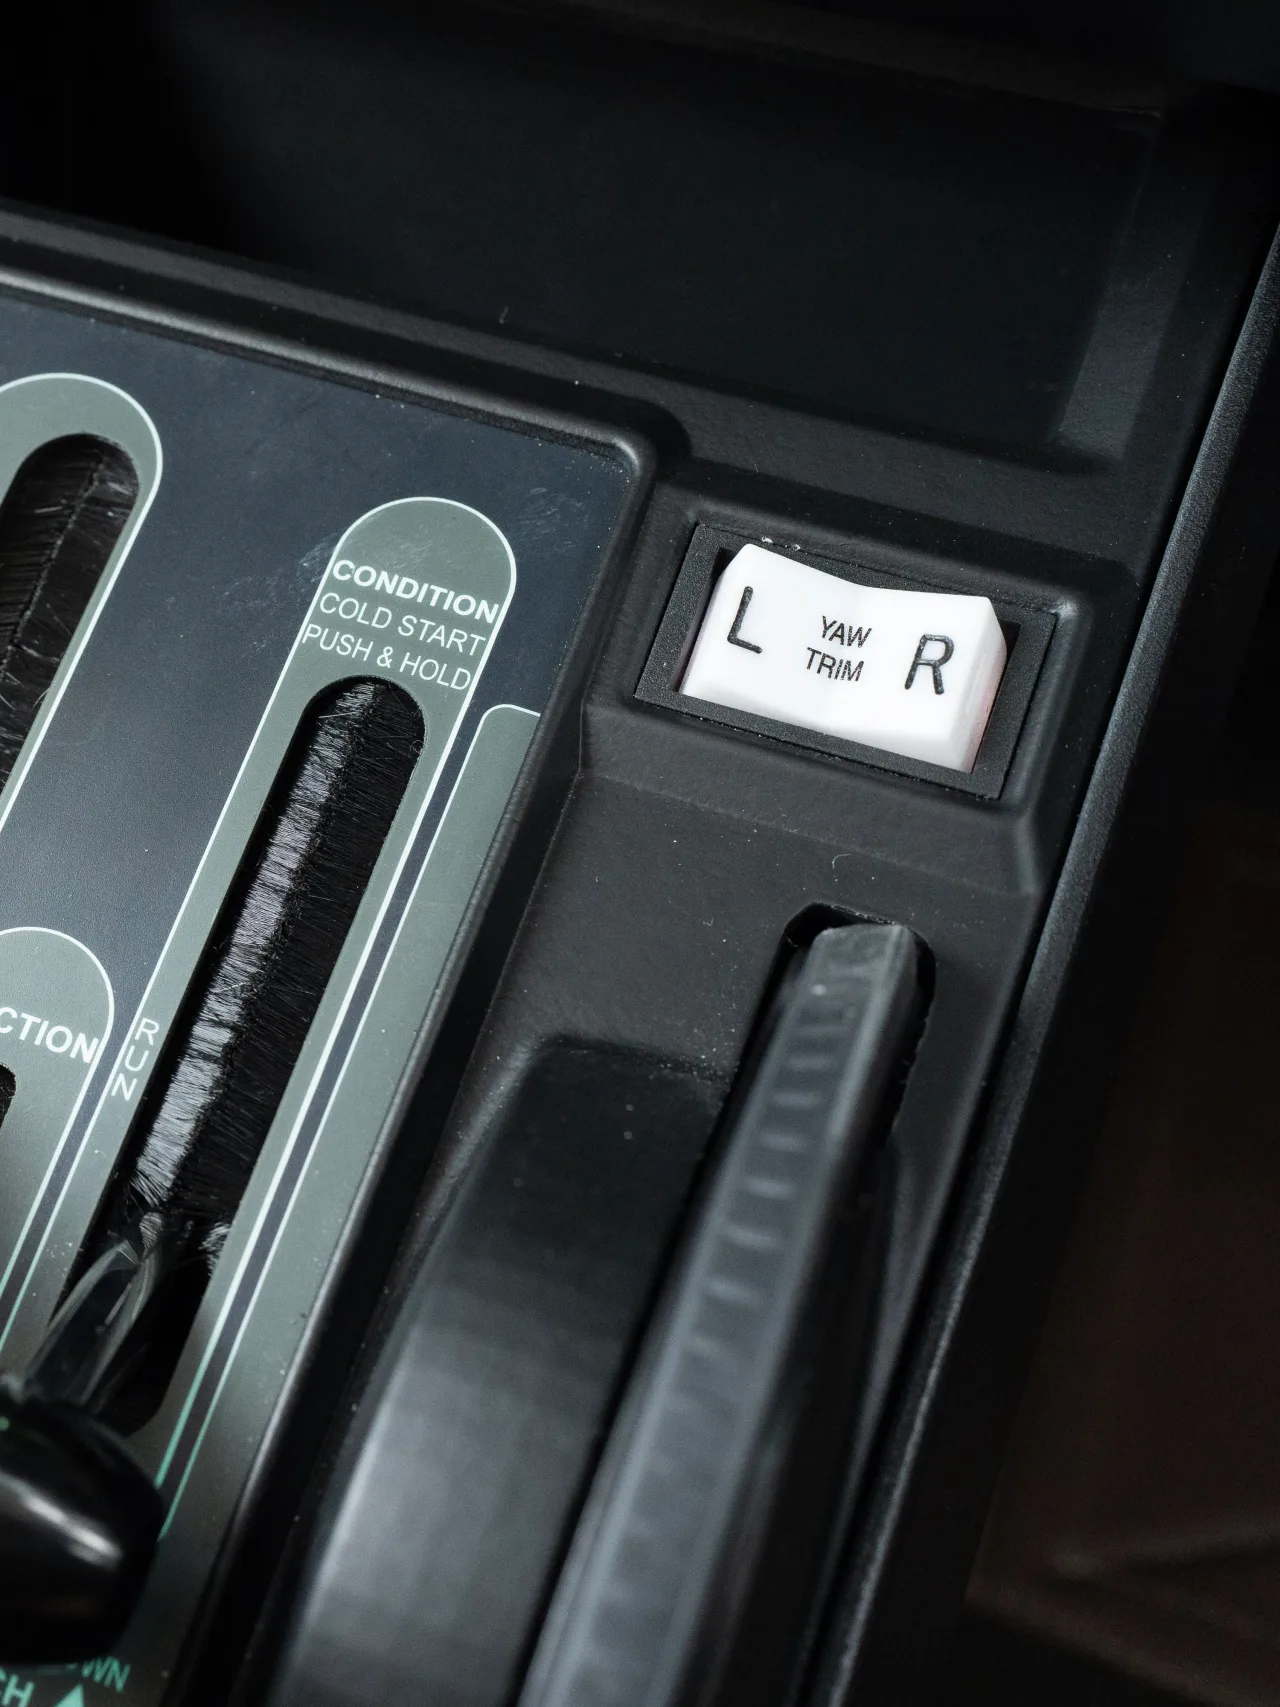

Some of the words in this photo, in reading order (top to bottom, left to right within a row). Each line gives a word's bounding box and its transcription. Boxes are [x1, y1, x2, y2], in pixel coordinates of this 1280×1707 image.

[332, 559, 500, 624] CONDITION
[726, 585, 763, 655] L
[319, 592, 393, 629] COLD
[397, 614, 487, 656] START
[820, 615, 873, 649] YAW
[301, 623, 374, 661] PUSH
[376, 645, 394, 668] &
[399, 651, 472, 690] HOLD
[805, 646, 865, 682] TRIM
[904, 633, 955, 695] R
[111, 1017, 160, 1101] RUN
